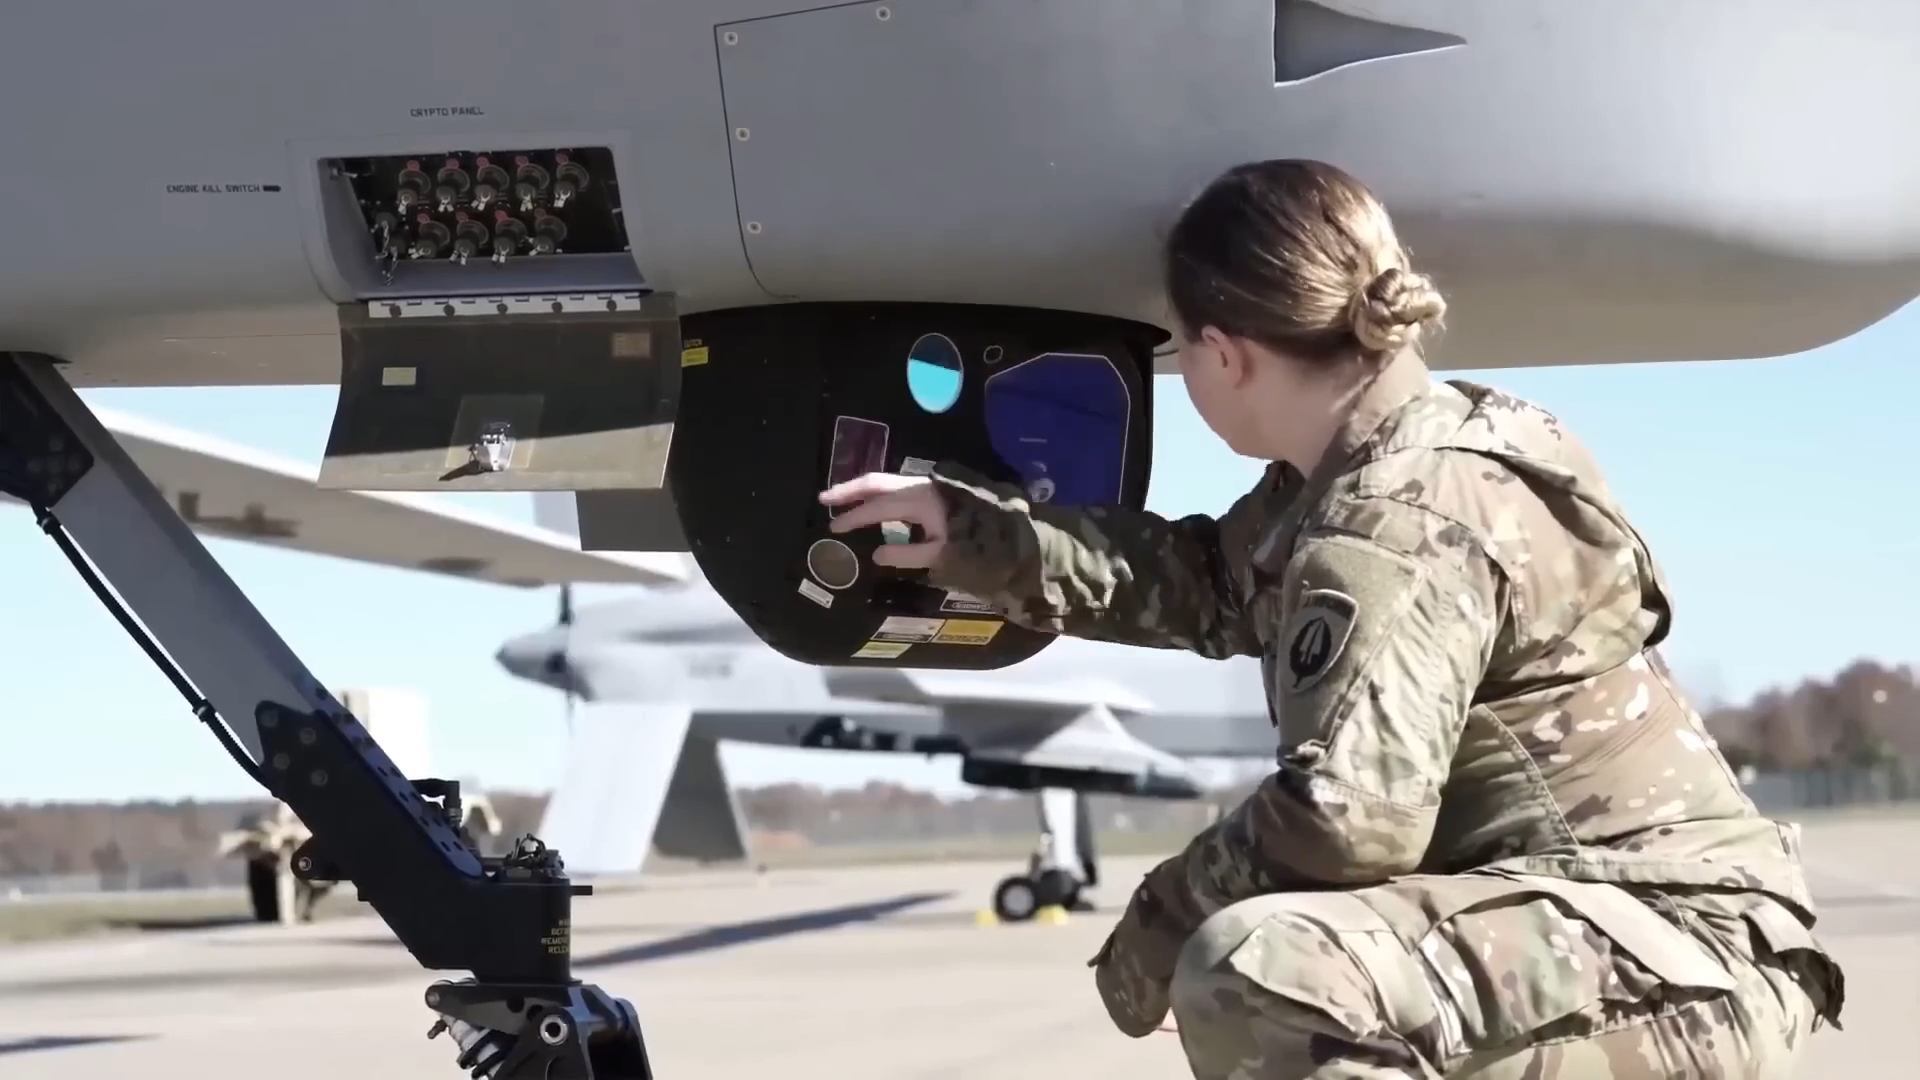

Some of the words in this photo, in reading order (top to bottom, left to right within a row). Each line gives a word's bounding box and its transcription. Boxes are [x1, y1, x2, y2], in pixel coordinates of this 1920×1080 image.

[410, 107, 449, 117] CRYPTO
[451, 107, 485, 116] PANEL
[166, 184, 199, 193] ENGINE
[202, 184, 222, 193] KILL
[225, 184, 260, 193] SWITCH
